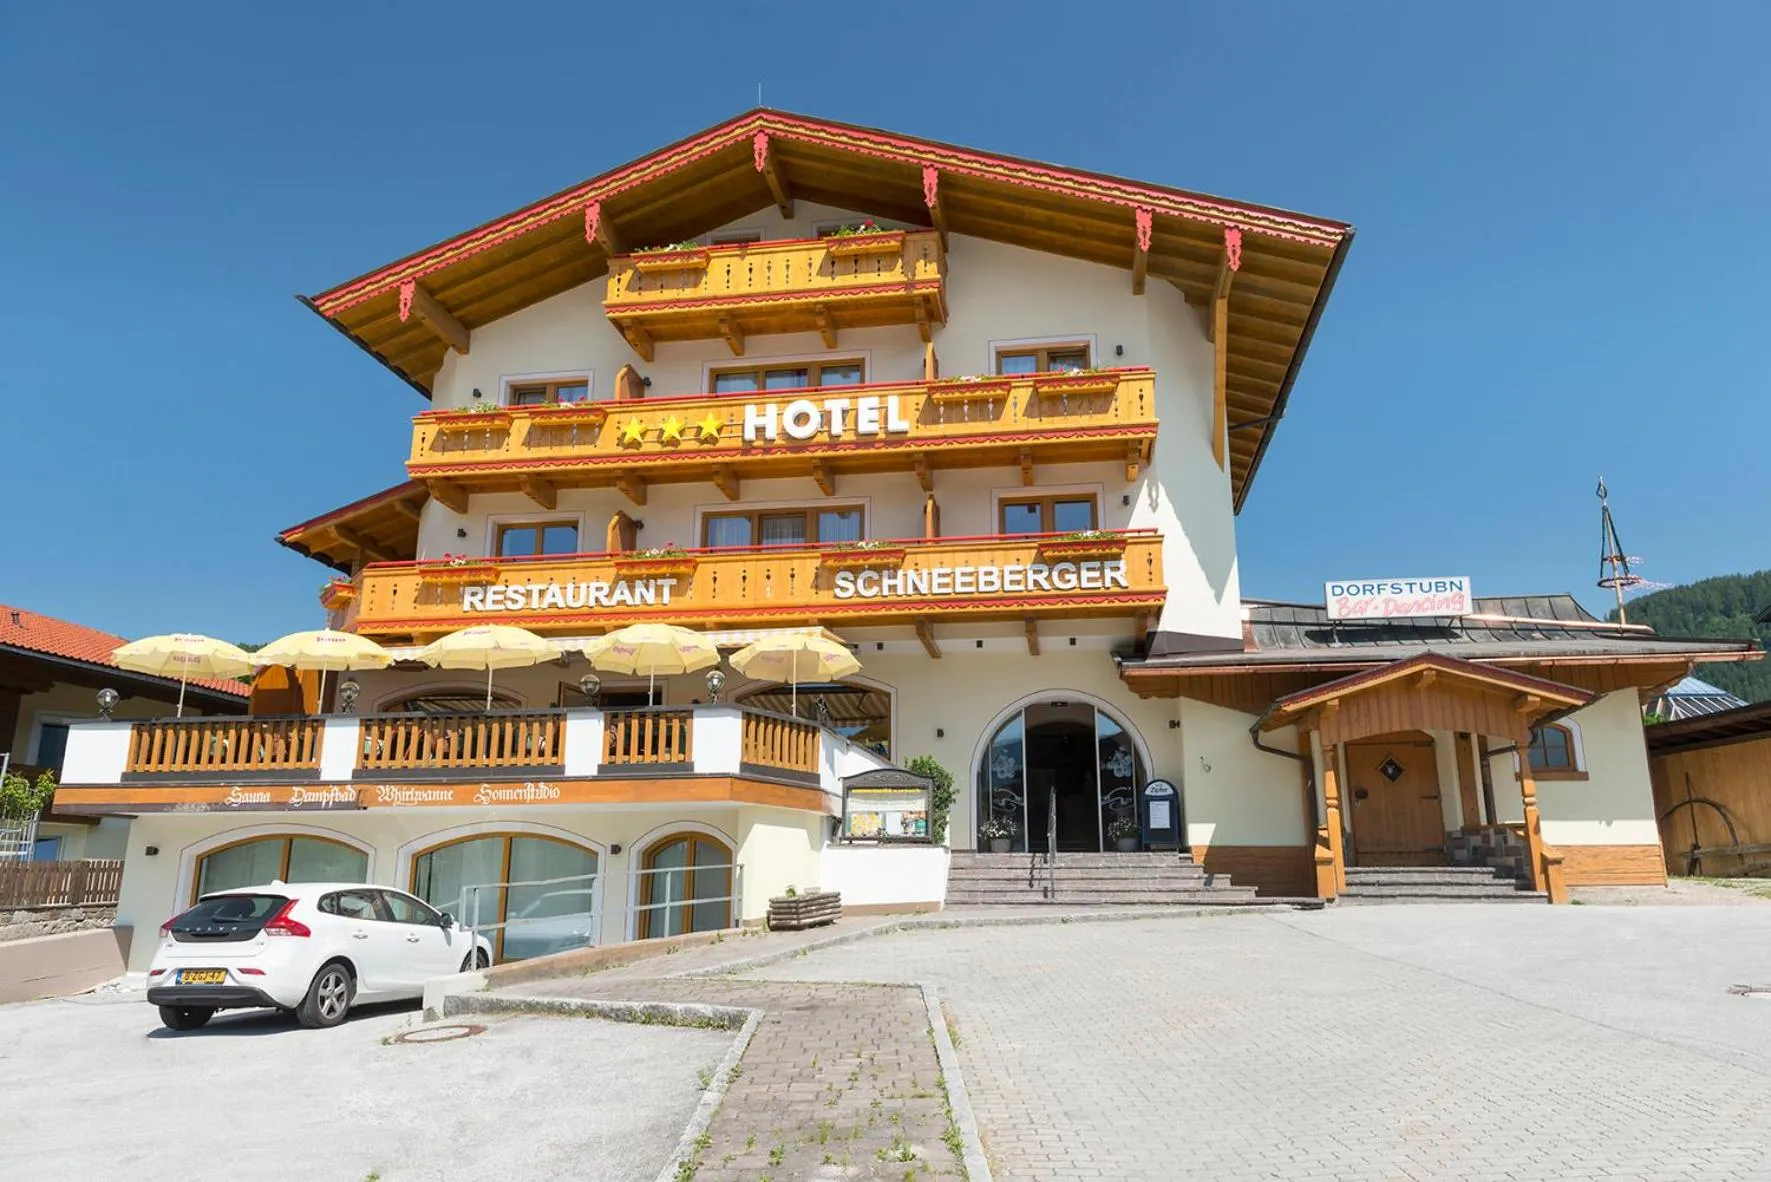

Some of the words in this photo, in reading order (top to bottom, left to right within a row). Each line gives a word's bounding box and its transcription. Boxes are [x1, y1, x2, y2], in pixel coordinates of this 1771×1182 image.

[744, 395, 909, 441] HOTEL
[463, 578, 677, 612] RESTAURANT
[834, 560, 1128, 598] SCHNEEBERGER
[1331, 580, 1464, 596] DORFSTUBN
[1336, 596, 1373, 617] Bar
[1382, 592, 1465, 616] Dancing
[224, 786, 272, 807] Sauna
[289, 785, 356, 808] Dampfbad
[376, 784, 454, 806] Whirlwanne
[473, 782, 561, 805] Sonnenstudio
